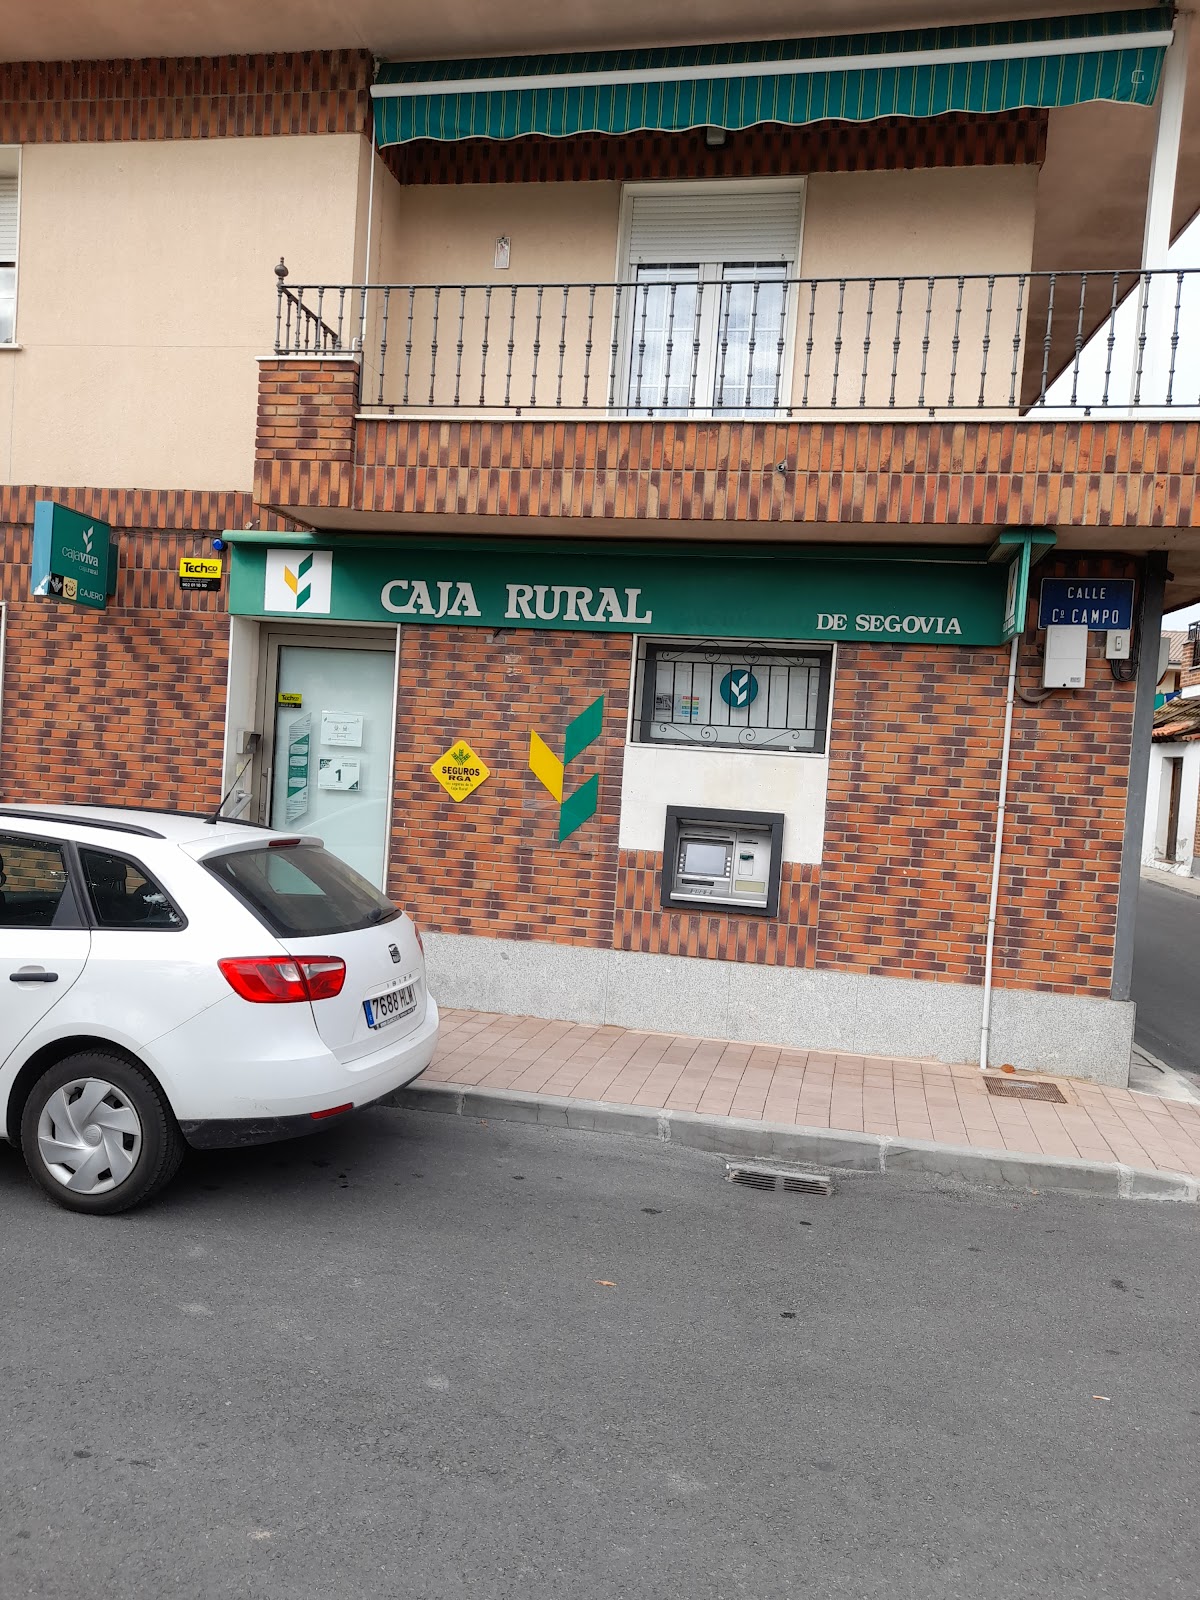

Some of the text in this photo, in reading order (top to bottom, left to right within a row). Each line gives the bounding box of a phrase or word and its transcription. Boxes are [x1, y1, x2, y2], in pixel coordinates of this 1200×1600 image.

[80, 588, 103, 601] CAJERO
[1068, 587, 1106, 599] CALLE
[381, 580, 652, 623] CAJA RURAL
[1072, 609, 1118, 624] CAMPO
[816, 614, 962, 634] DE SEGOVIA
[335, 769, 342, 781] 1
[442, 766, 480, 776] SEGUROS
[387, 974, 412, 988] IBIZA
[373, 992, 399, 1020] 7688
